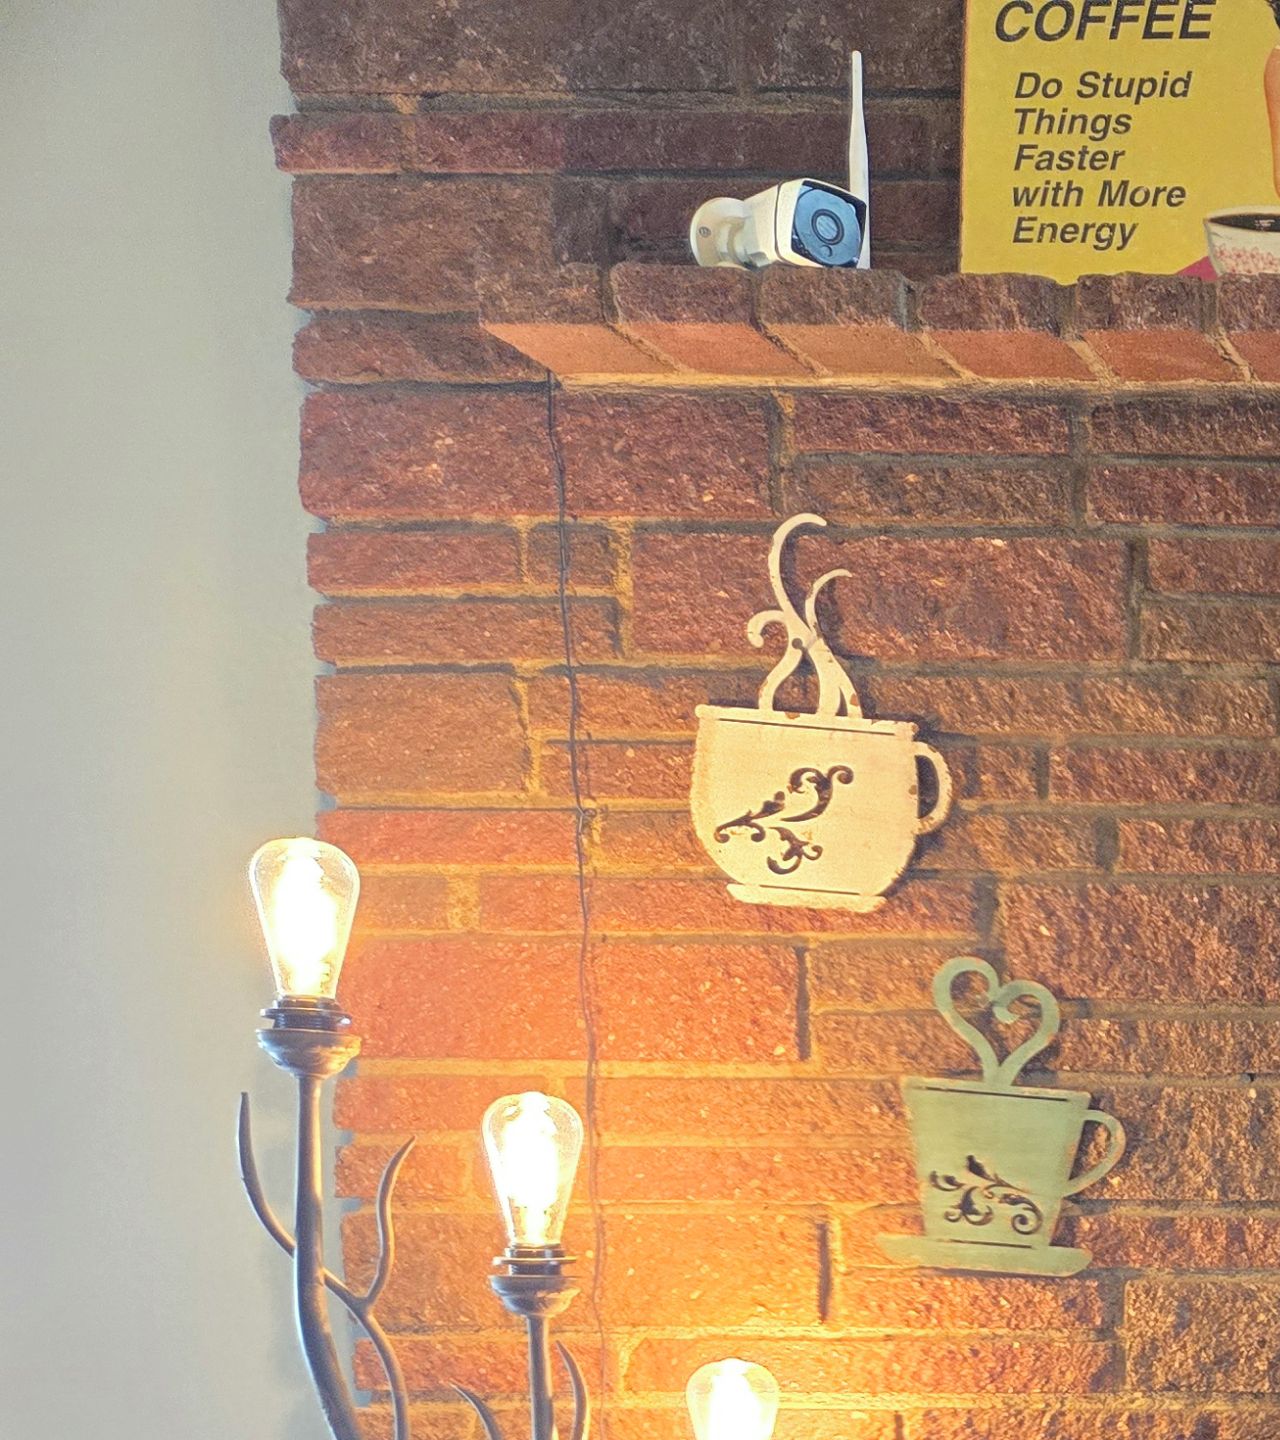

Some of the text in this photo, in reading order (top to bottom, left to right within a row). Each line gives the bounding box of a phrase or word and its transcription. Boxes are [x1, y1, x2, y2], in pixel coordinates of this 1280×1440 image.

[995, 0, 1217, 42] COFFEE
[1014, 70, 1193, 106] Do Stupid
[1014, 107, 1132, 142] Things
[1013, 144, 1126, 171] Faster
[1012, 179, 1187, 208] with More
[1012, 216, 1139, 251] Energy
